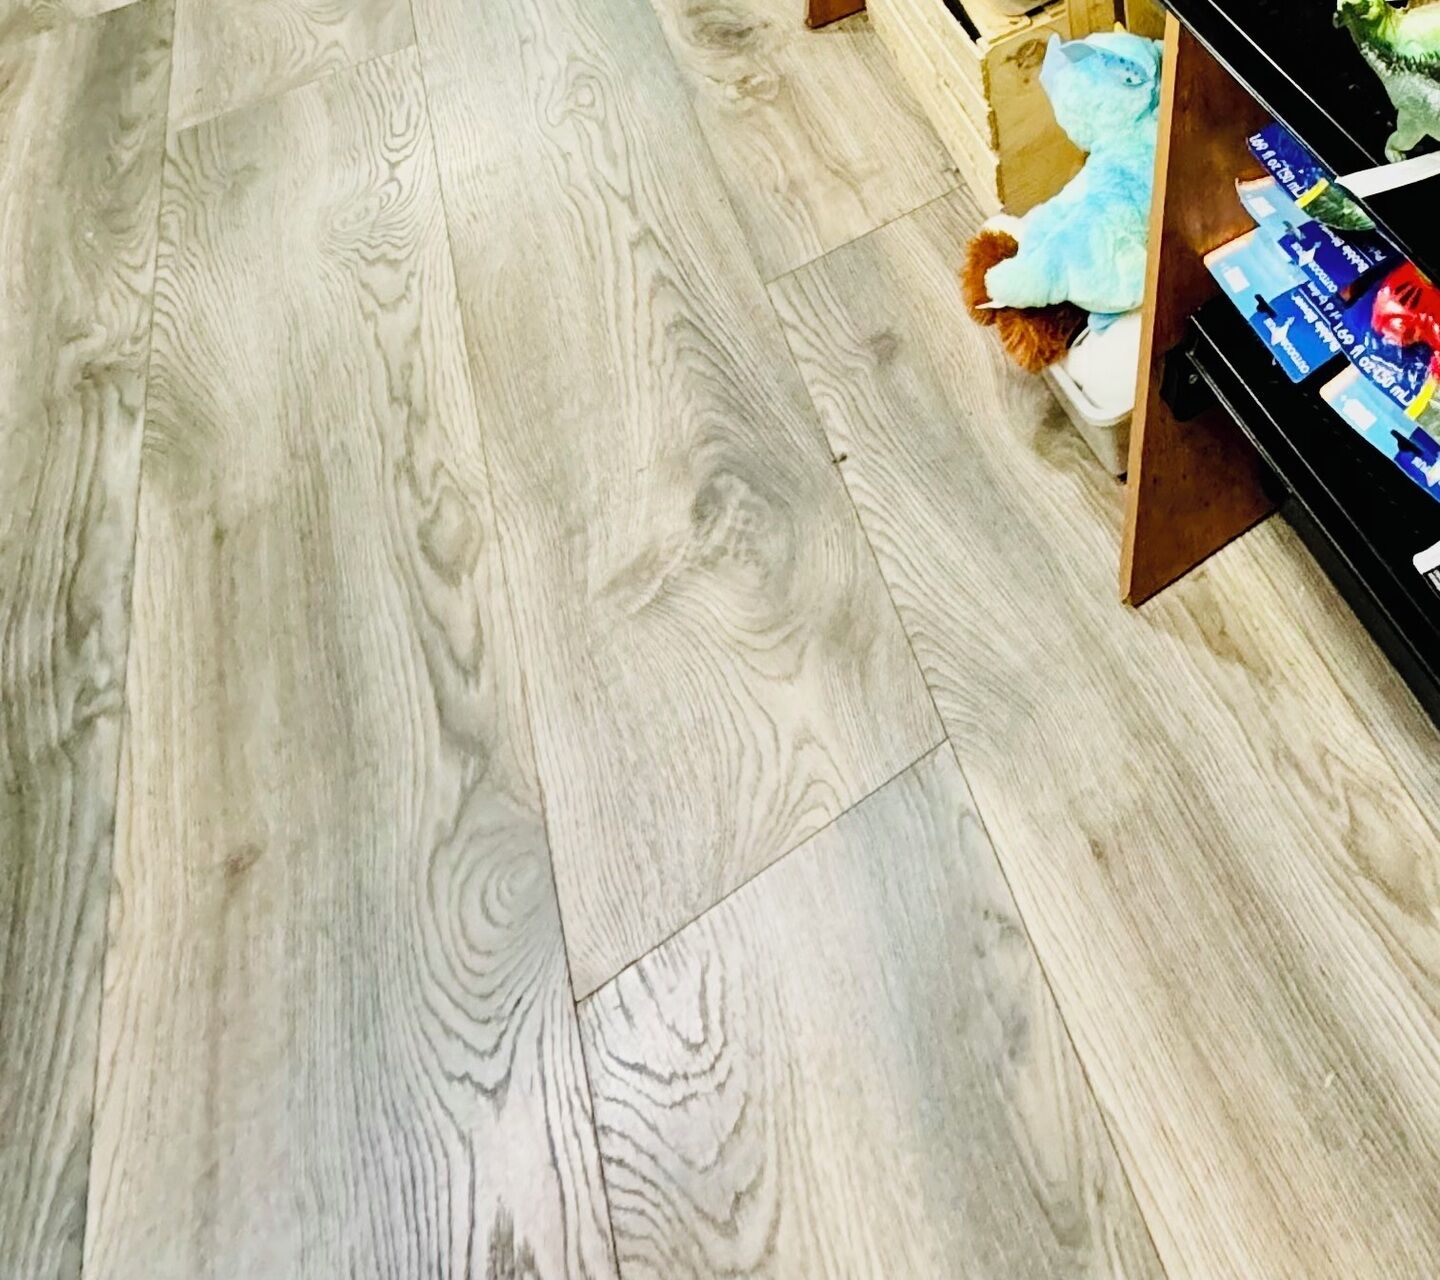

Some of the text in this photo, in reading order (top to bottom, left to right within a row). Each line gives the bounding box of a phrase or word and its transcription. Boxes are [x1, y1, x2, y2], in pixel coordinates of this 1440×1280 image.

[1342, 244, 1370, 274] Bubble
[1290, 291, 1319, 324] Blower
[1314, 320, 1341, 353] Bubble
[1333, 321, 1355, 345] 1.69
[1349, 343, 1366, 359] fl
